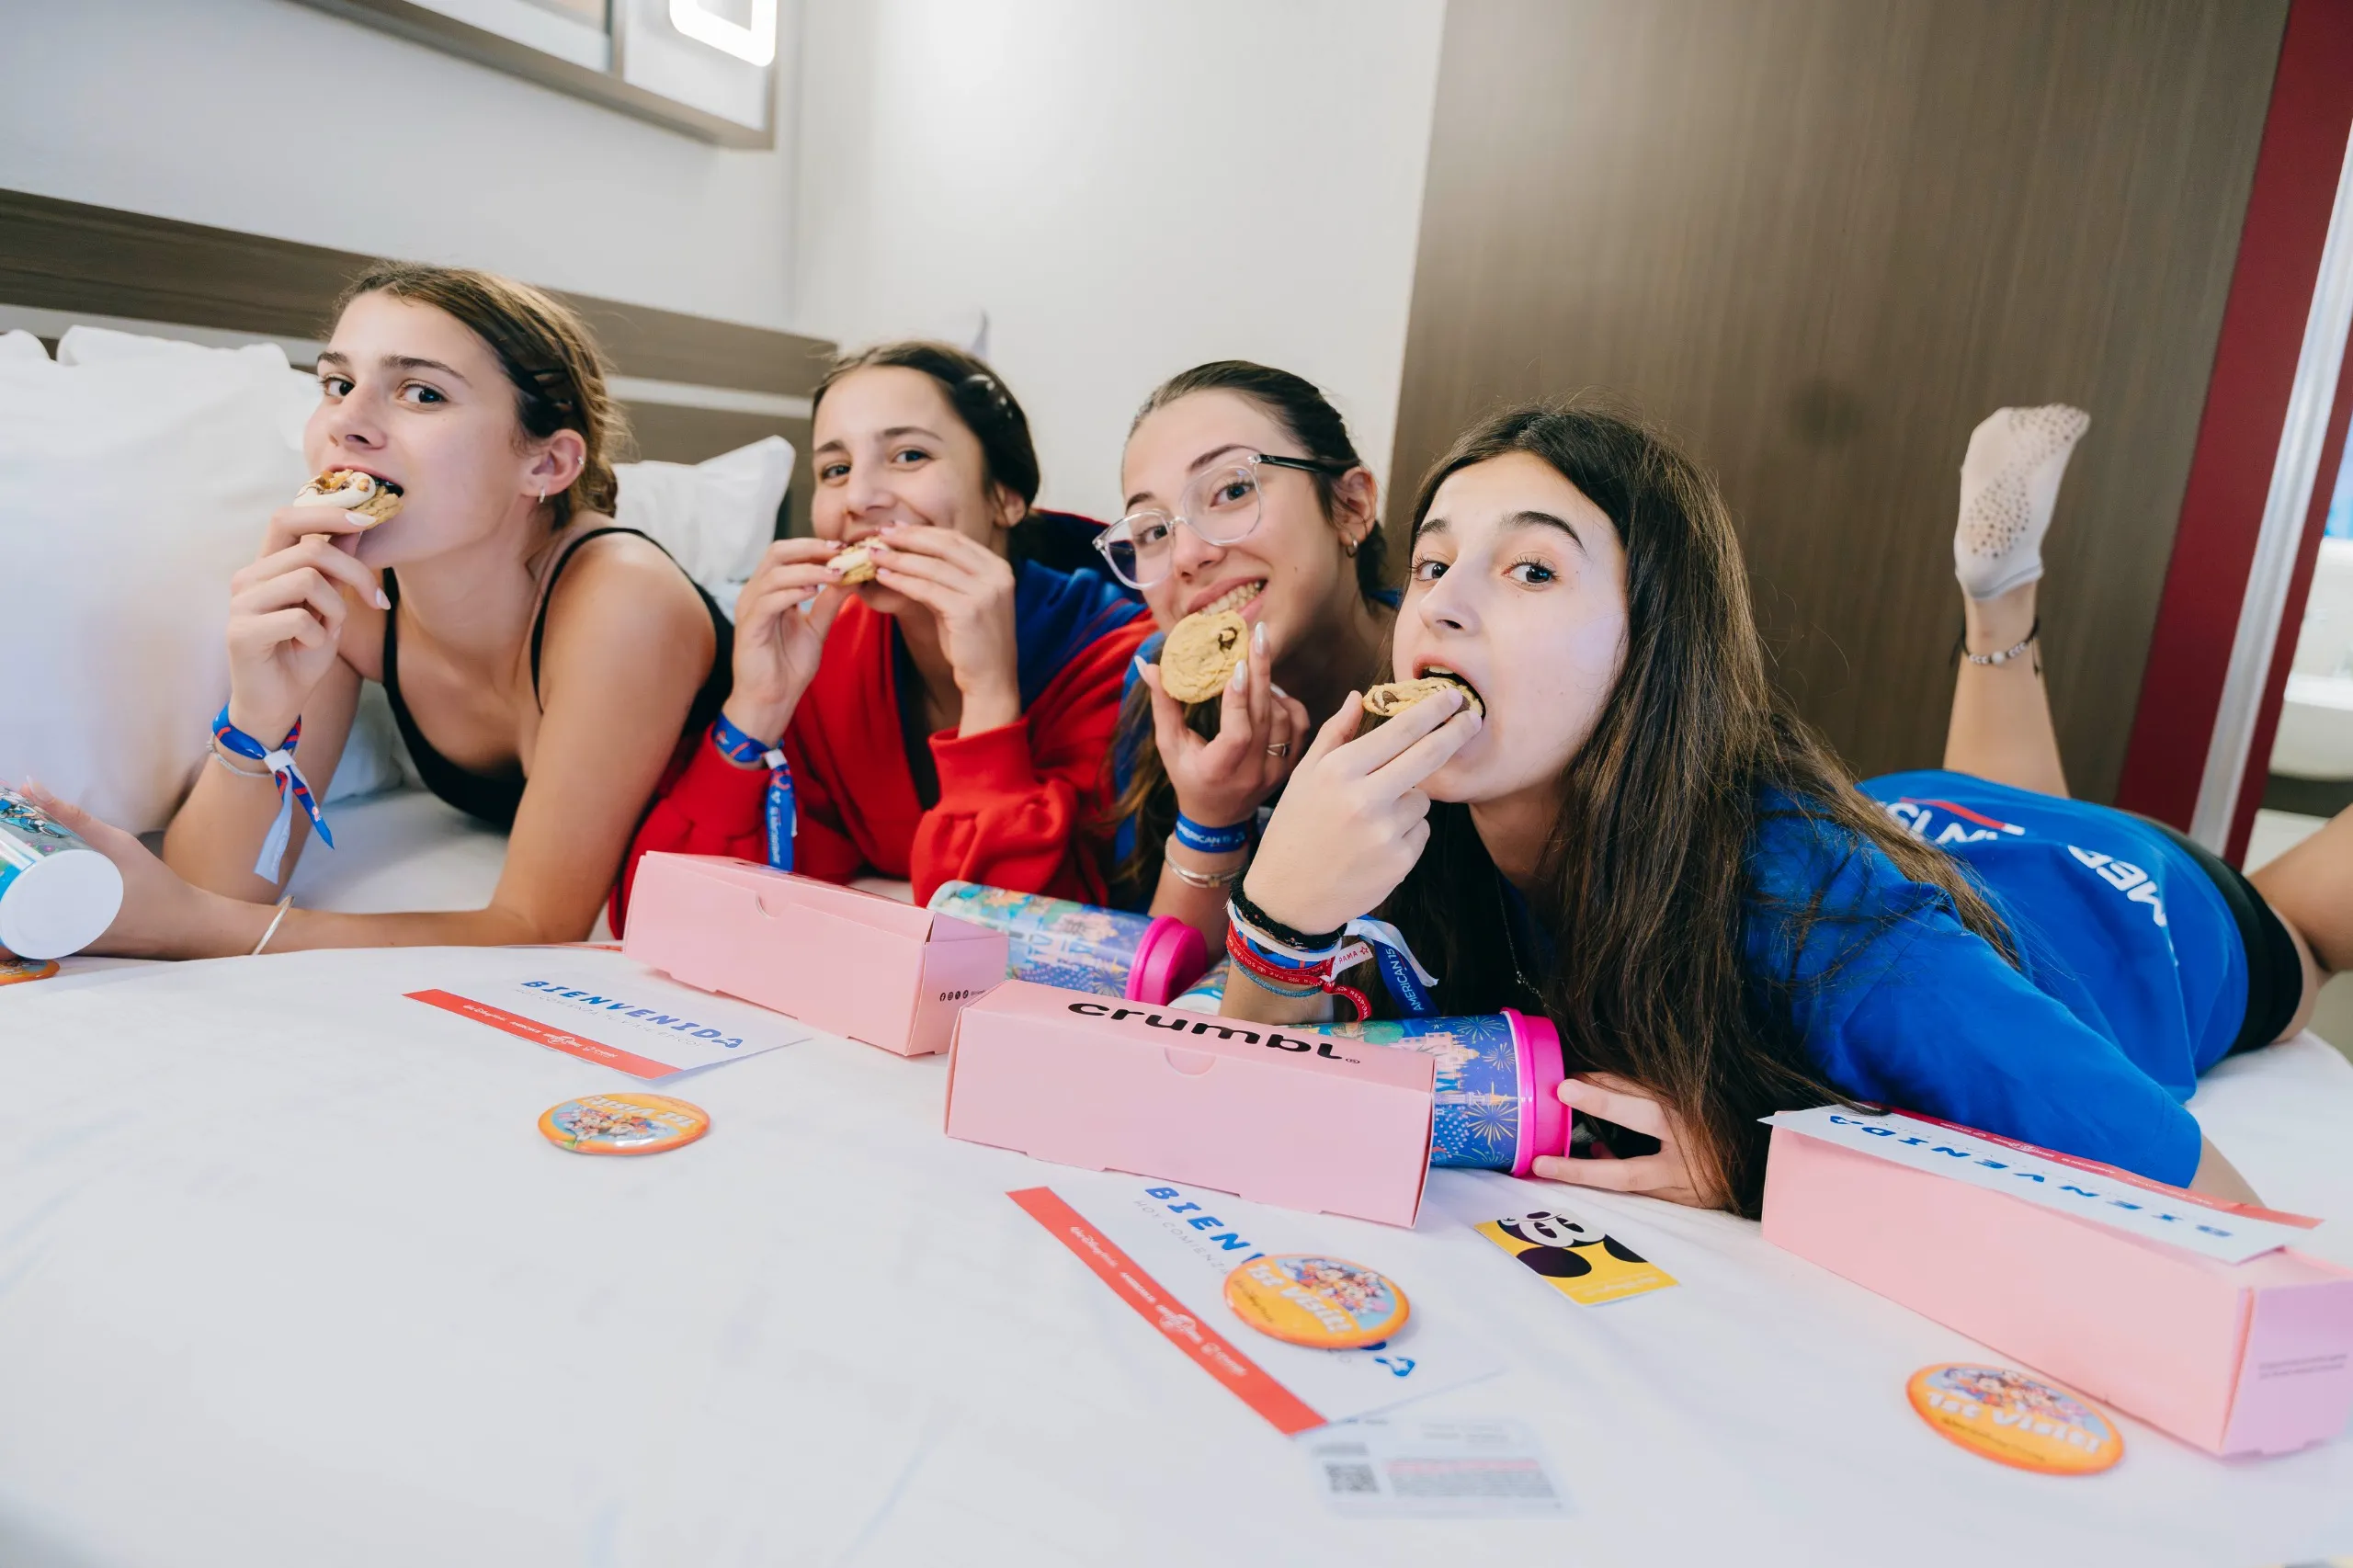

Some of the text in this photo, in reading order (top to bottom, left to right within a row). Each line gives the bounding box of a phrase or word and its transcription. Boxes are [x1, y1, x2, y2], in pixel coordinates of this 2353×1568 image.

[1385, 948, 1425, 1011] AMERICAN 15
[520, 981, 744, 1049] BIENVENIDA
[1068, 1003, 1343, 1060] crumbl
[1829, 1115, 2234, 1237] BIENVENIDA
[1247, 1264, 1285, 1287] 1st
[1279, 1287, 1353, 1333] Visit!
[1927, 1392, 1981, 1418] 1st
